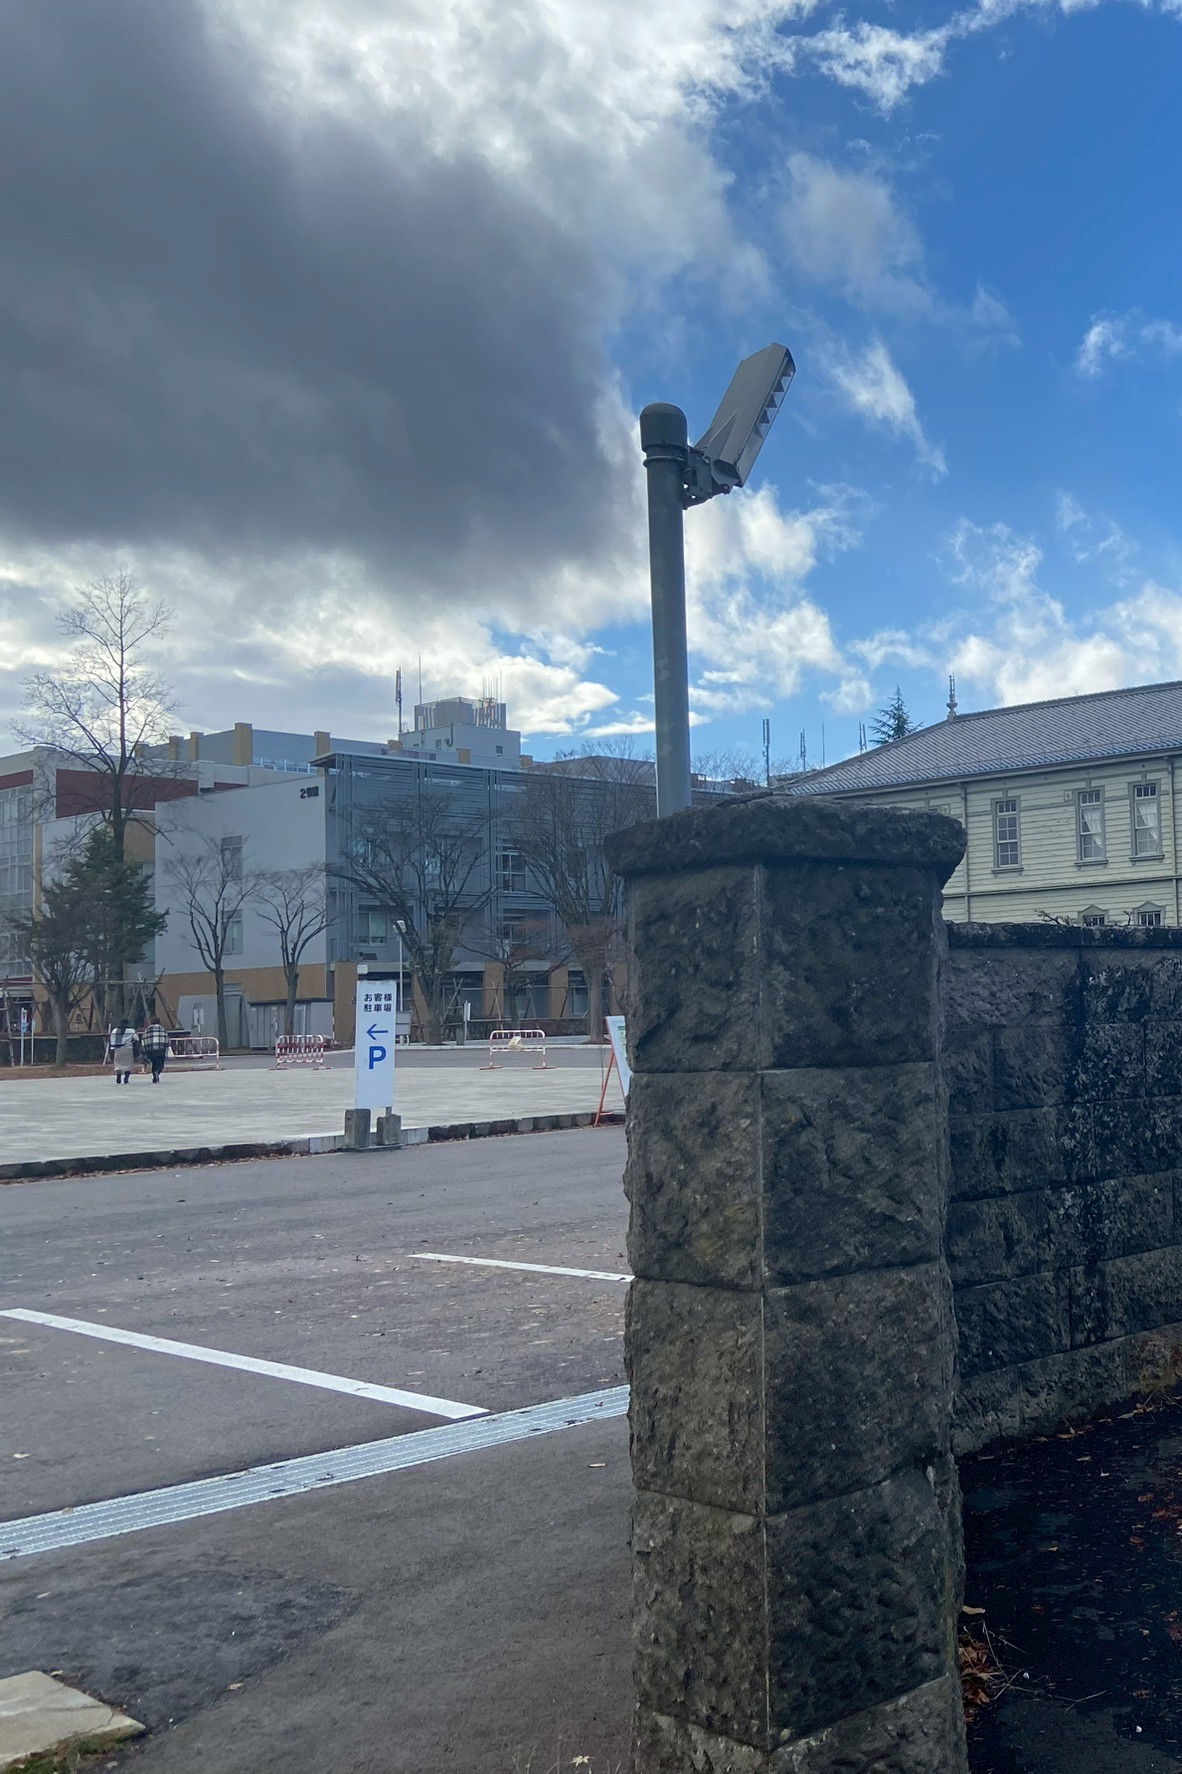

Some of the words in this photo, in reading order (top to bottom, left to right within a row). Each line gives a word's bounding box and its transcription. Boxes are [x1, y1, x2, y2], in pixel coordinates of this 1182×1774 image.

[364, 993, 392, 1002] お客様
[364, 1004, 392, 1013] 駐車場
[369, 1046, 386, 1069] P
